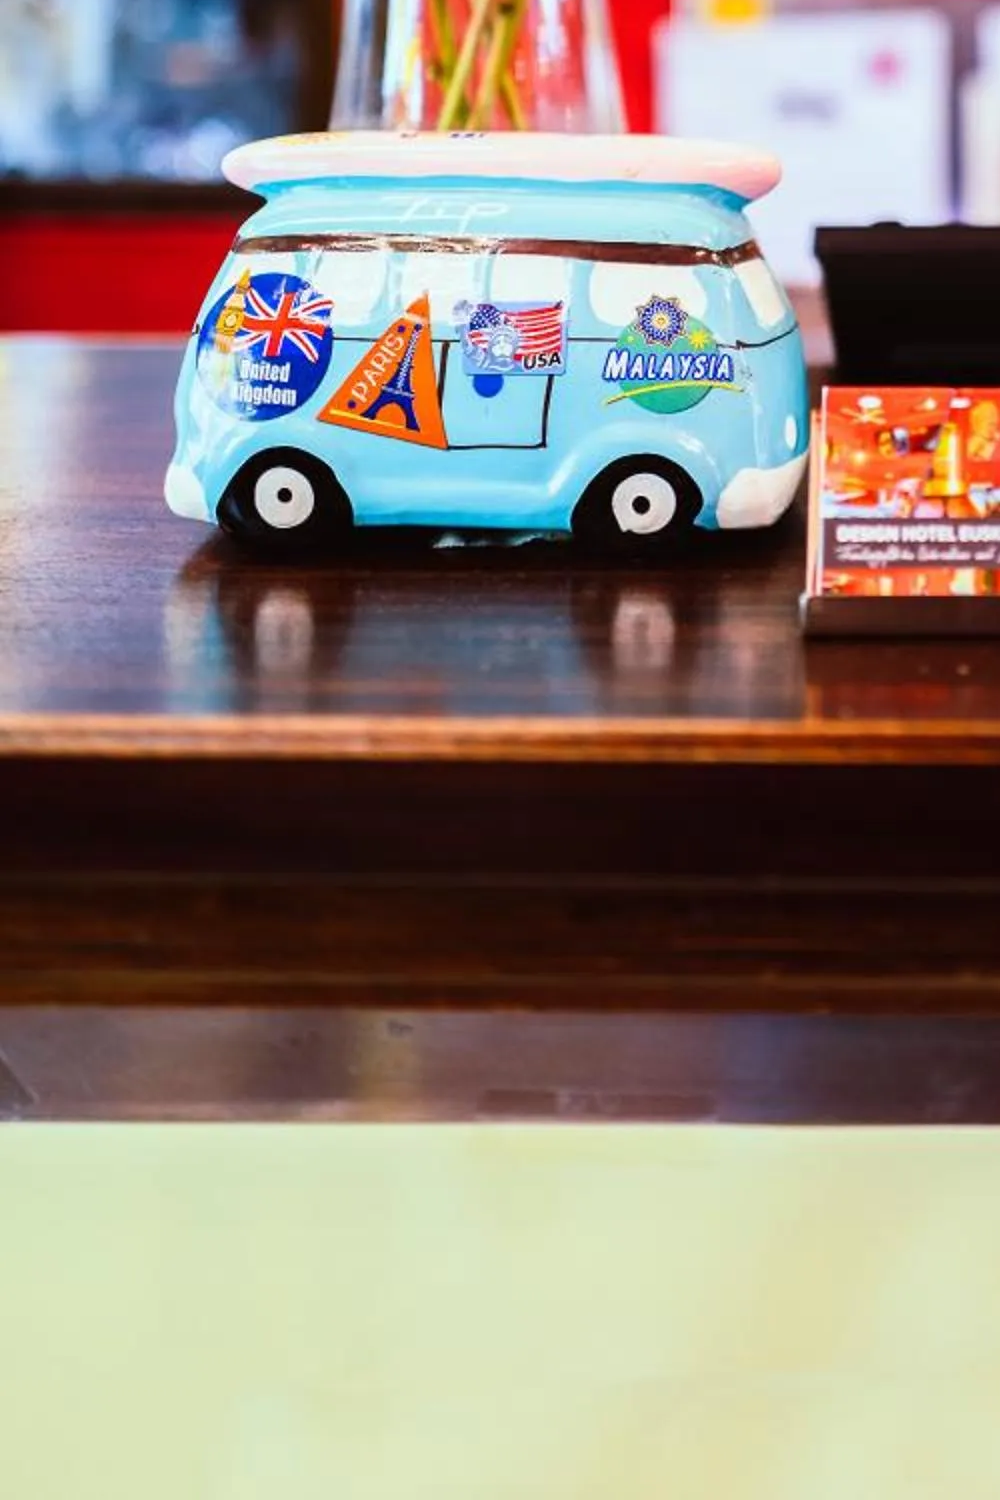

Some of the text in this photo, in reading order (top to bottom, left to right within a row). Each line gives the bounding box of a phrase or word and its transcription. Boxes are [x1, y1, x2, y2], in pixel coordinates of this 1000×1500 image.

[240, 359, 291, 383] United
[351, 333, 405, 404] PARIS
[523, 351, 561, 370] USA
[602, 347, 734, 381] MALAYSIA
[901, 525, 956, 542] HOTEL
